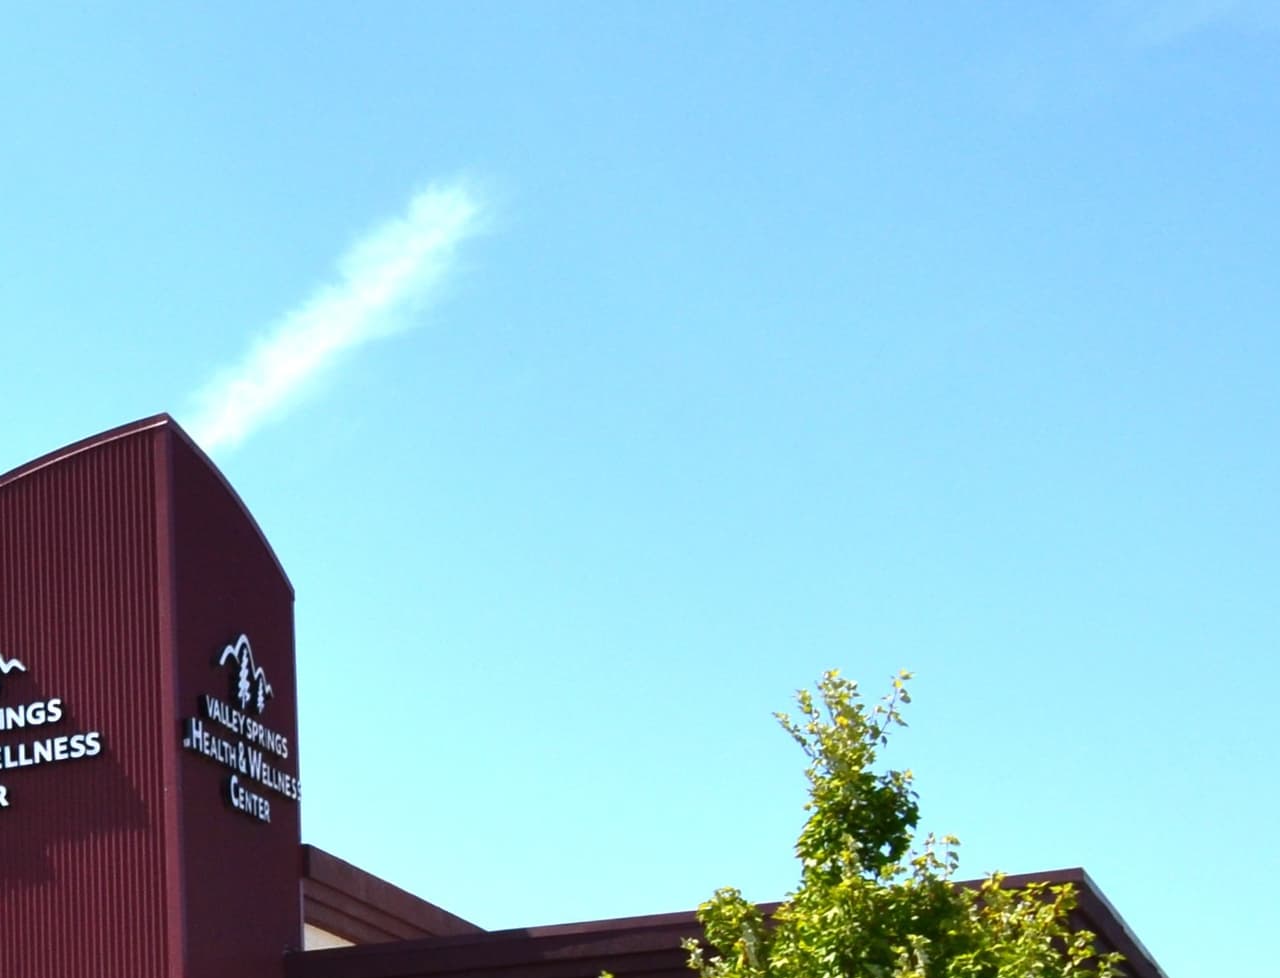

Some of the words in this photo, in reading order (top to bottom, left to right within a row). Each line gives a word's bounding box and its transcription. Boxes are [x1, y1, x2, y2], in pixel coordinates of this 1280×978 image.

[191, 716, 238, 769] HEALTH
[238, 741, 248, 774] &
[206, 694, 246, 735] VALLEY
[246, 717, 289, 759] SPRINGS
[230, 774, 271, 823] CENTER
